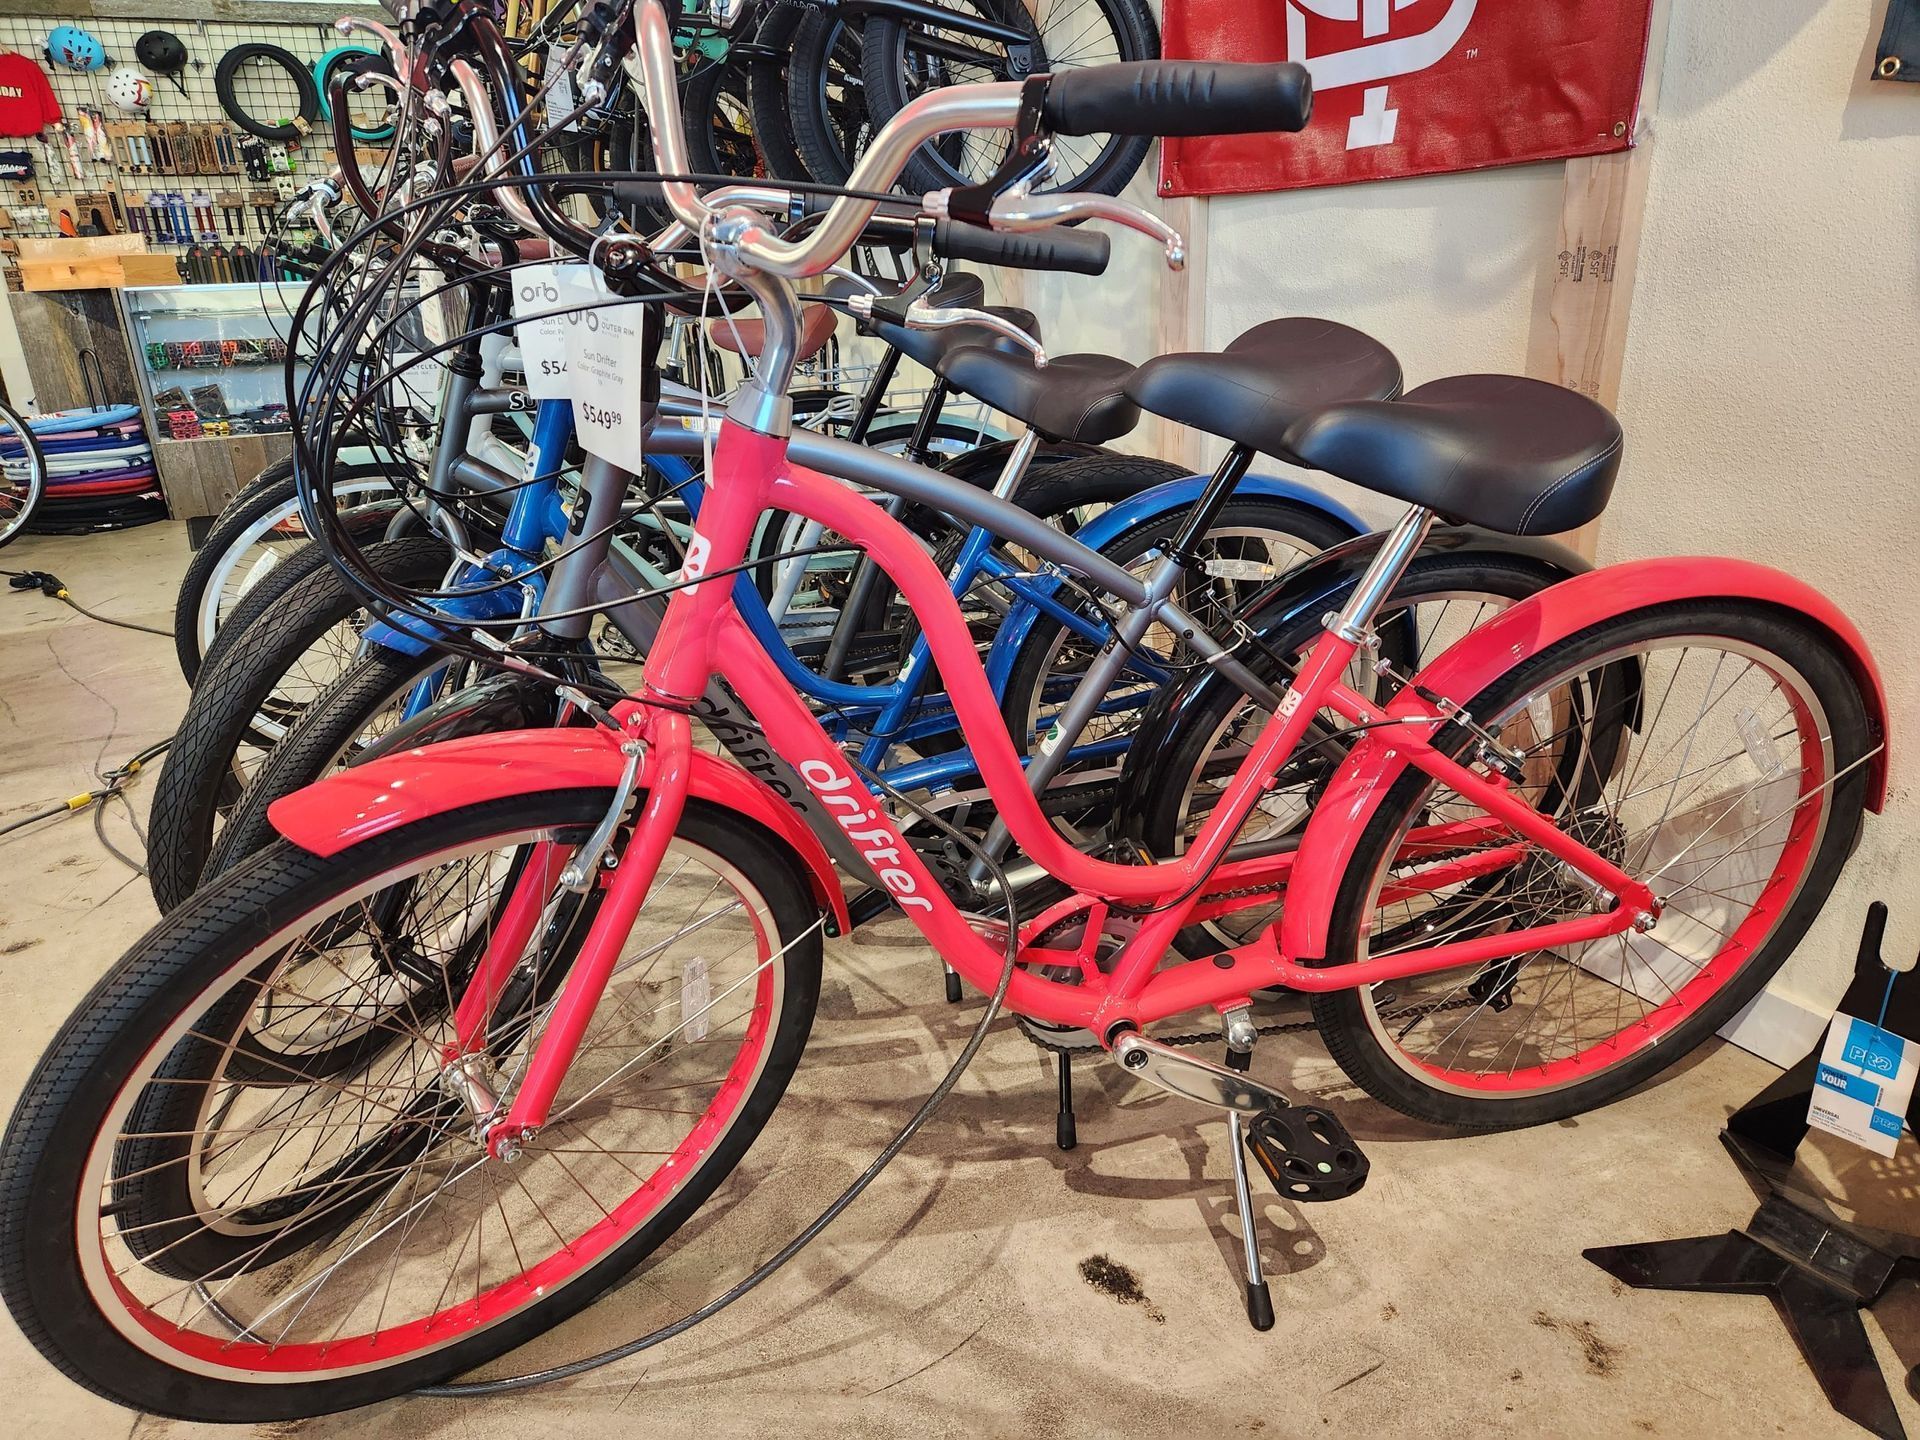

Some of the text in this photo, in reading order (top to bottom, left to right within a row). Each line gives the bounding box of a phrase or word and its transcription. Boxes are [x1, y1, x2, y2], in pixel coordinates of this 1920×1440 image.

[1466, 48, 1478, 60] TM
[0, 86, 23, 98] DAY
[520, 282, 559, 302] orb
[541, 317, 556, 326] Sun
[601, 321, 635, 336] OUTER RIM
[583, 348, 617, 368] Sun Drifter
[799, 759, 934, 913] drifter
[1821, 1071, 1848, 1090] YOUR
[1813, 1104, 1840, 1119] UNIVERSAL
